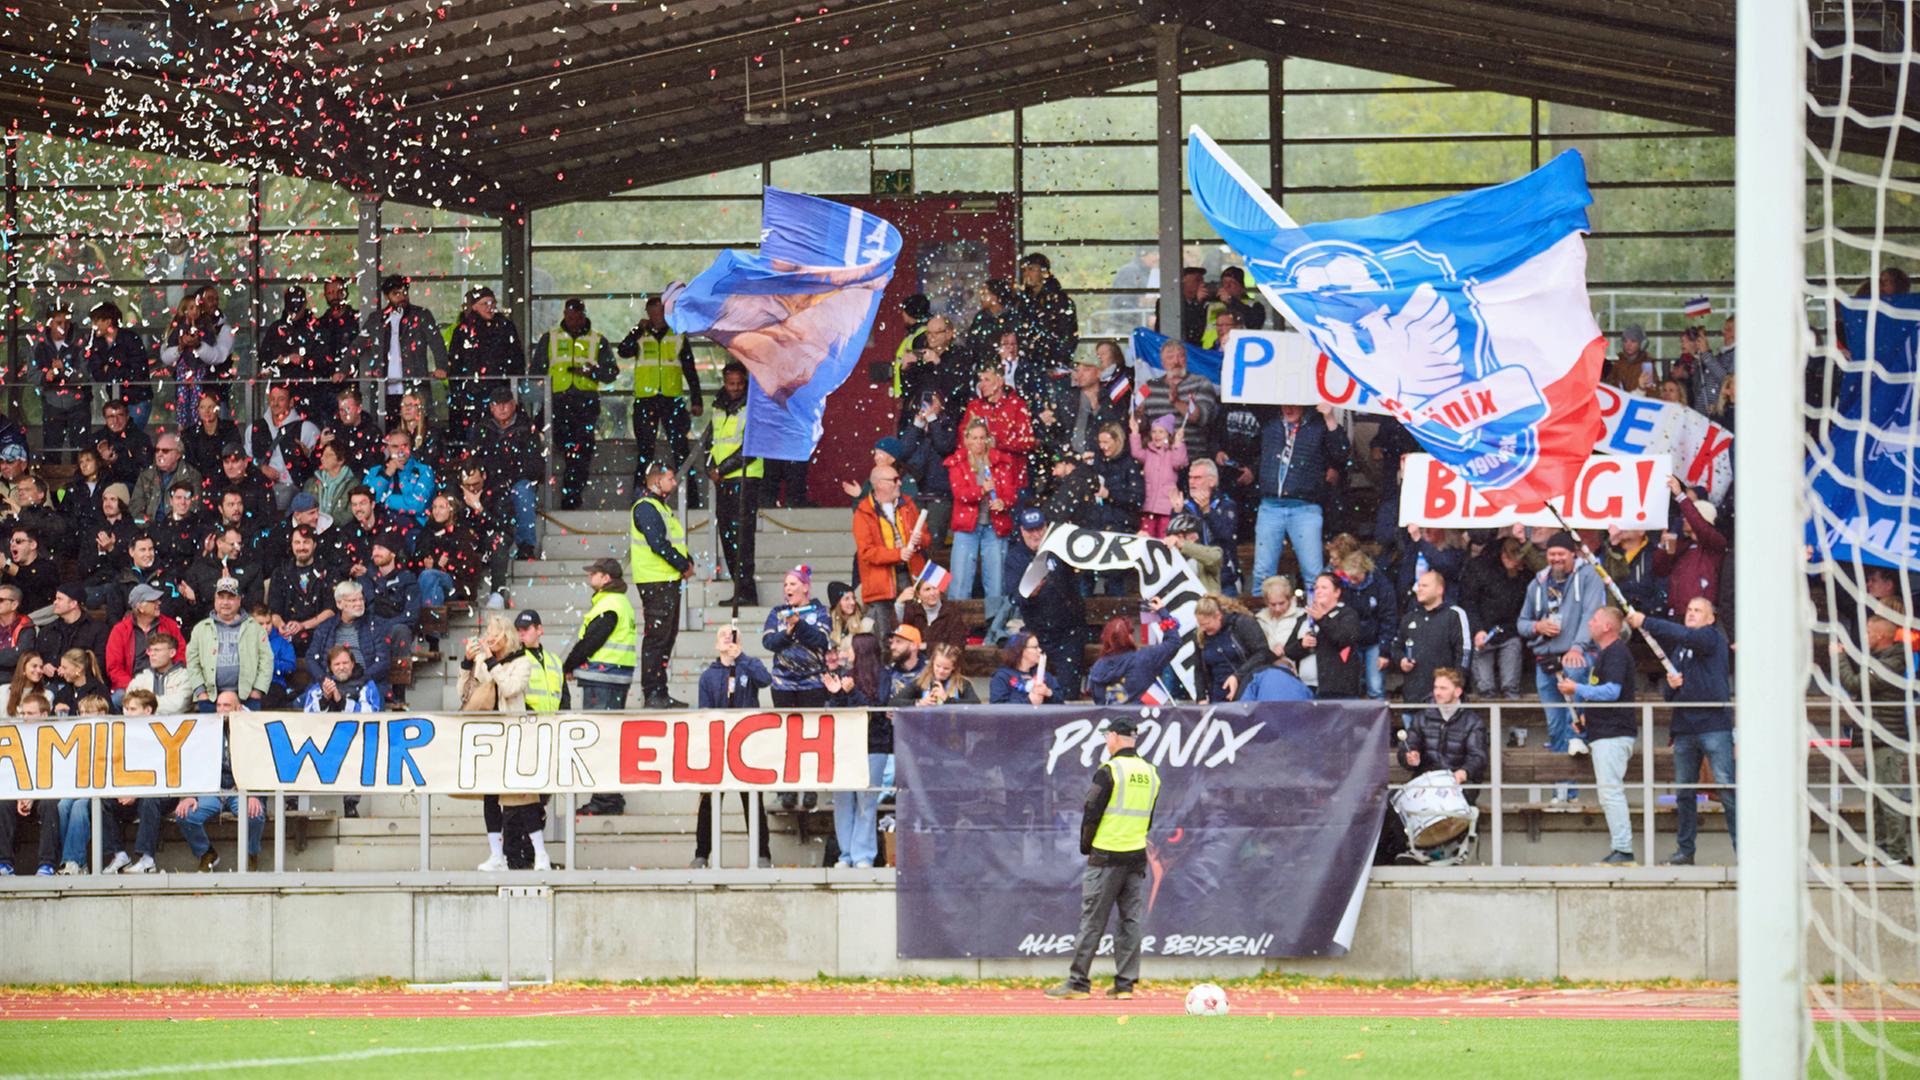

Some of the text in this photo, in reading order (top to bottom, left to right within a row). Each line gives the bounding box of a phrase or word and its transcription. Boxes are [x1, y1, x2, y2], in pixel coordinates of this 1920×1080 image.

[1424, 459, 1655, 522] BIIG!
[0, 719, 197, 791] AMILY
[264, 712, 834, 789] WIR FÜR EUCH
[1129, 773, 1150, 785] ABS
[1017, 934, 1076, 956] ALLE
[1160, 934, 1274, 957] BEISSEN!
